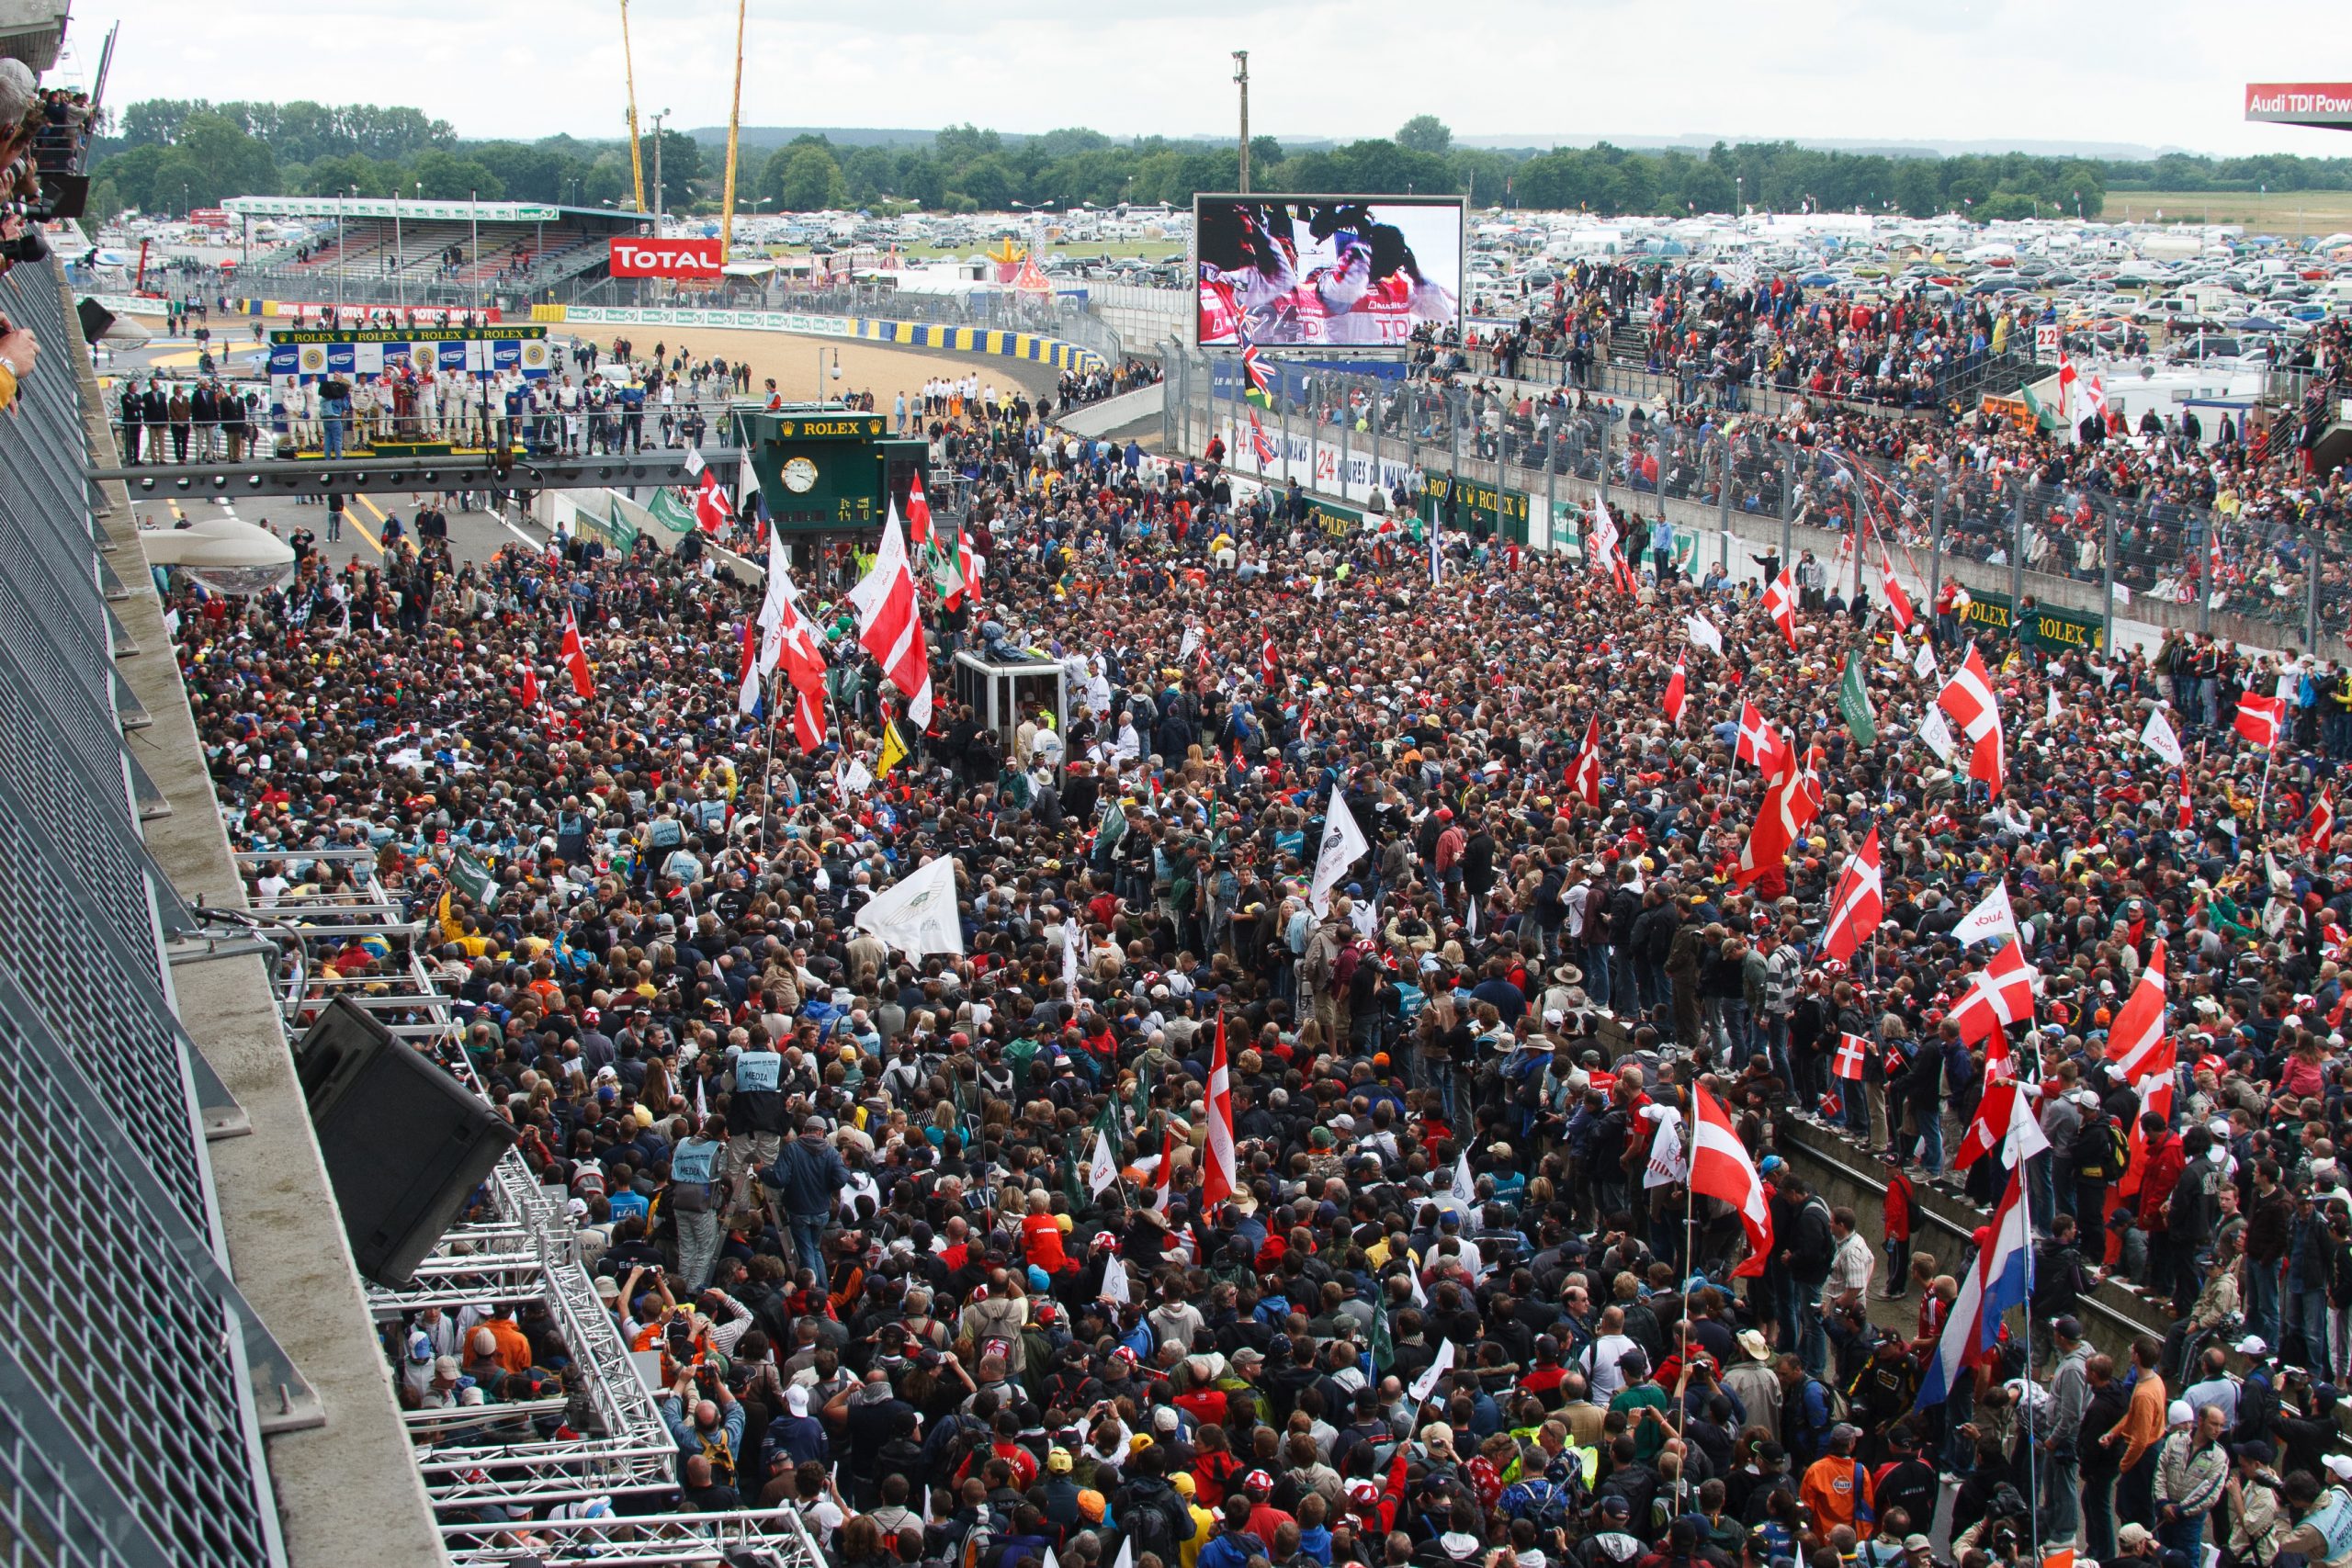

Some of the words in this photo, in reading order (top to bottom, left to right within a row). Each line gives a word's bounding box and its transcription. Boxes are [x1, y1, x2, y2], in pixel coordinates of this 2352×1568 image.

[2250, 95, 2285, 112] Audi
[2288, 96, 2312, 112] TDI
[615, 247, 718, 268] TOTAL
[294, 333, 334, 343] ROLEX
[357, 333, 399, 342] ROLEX
[421, 331, 461, 340] ROLEX
[483, 330, 524, 339] ROLEX
[2038, 330, 2055, 345] 22
[804, 423, 859, 434] ROLEX
[1317, 449, 1335, 480] 24
[1338, 459, 1366, 485] HURES
[838, 510, 852, 522] 14
[1969, 601, 2009, 627] OLEX
[745, 1071, 768, 1082] MEDIA
[681, 1166, 701, 1177] MEDIA
